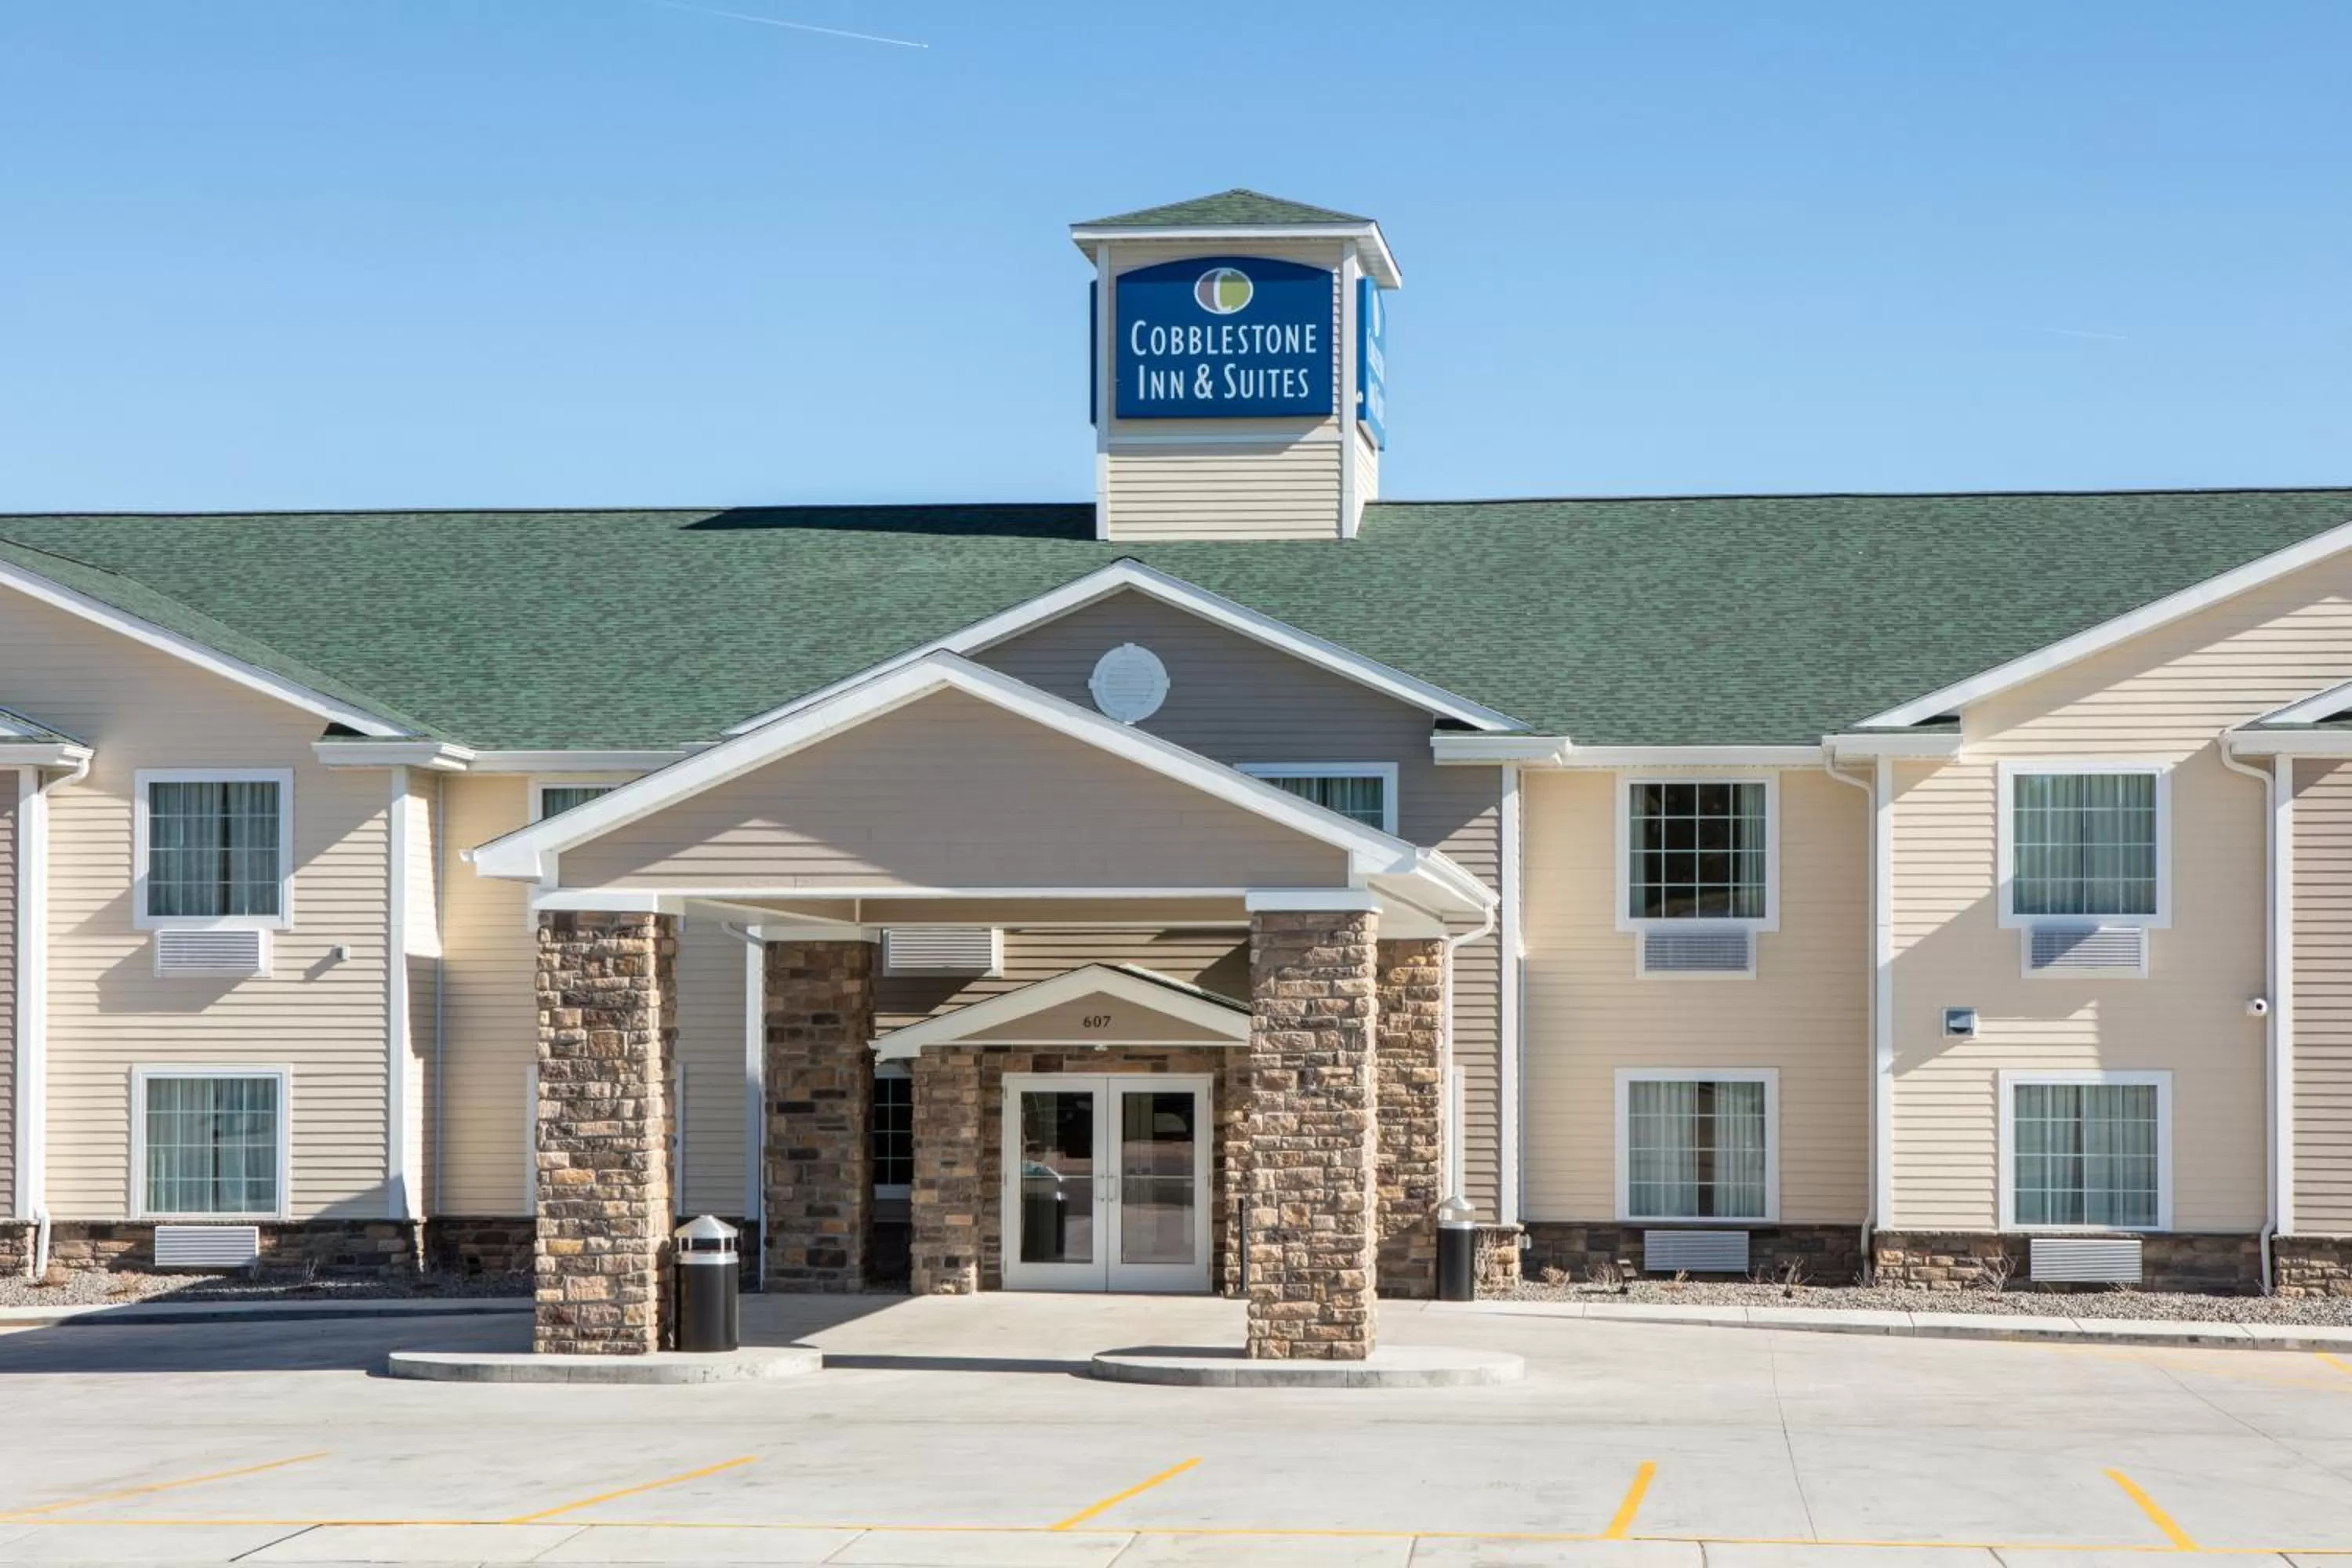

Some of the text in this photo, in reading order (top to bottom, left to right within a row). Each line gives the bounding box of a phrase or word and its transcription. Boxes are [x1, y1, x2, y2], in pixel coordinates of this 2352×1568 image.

[1131, 320, 1317, 356] COBBLESTONE
[1138, 363, 1308, 400] INN & SUITES
[1083, 1015, 1111, 1028] 607
